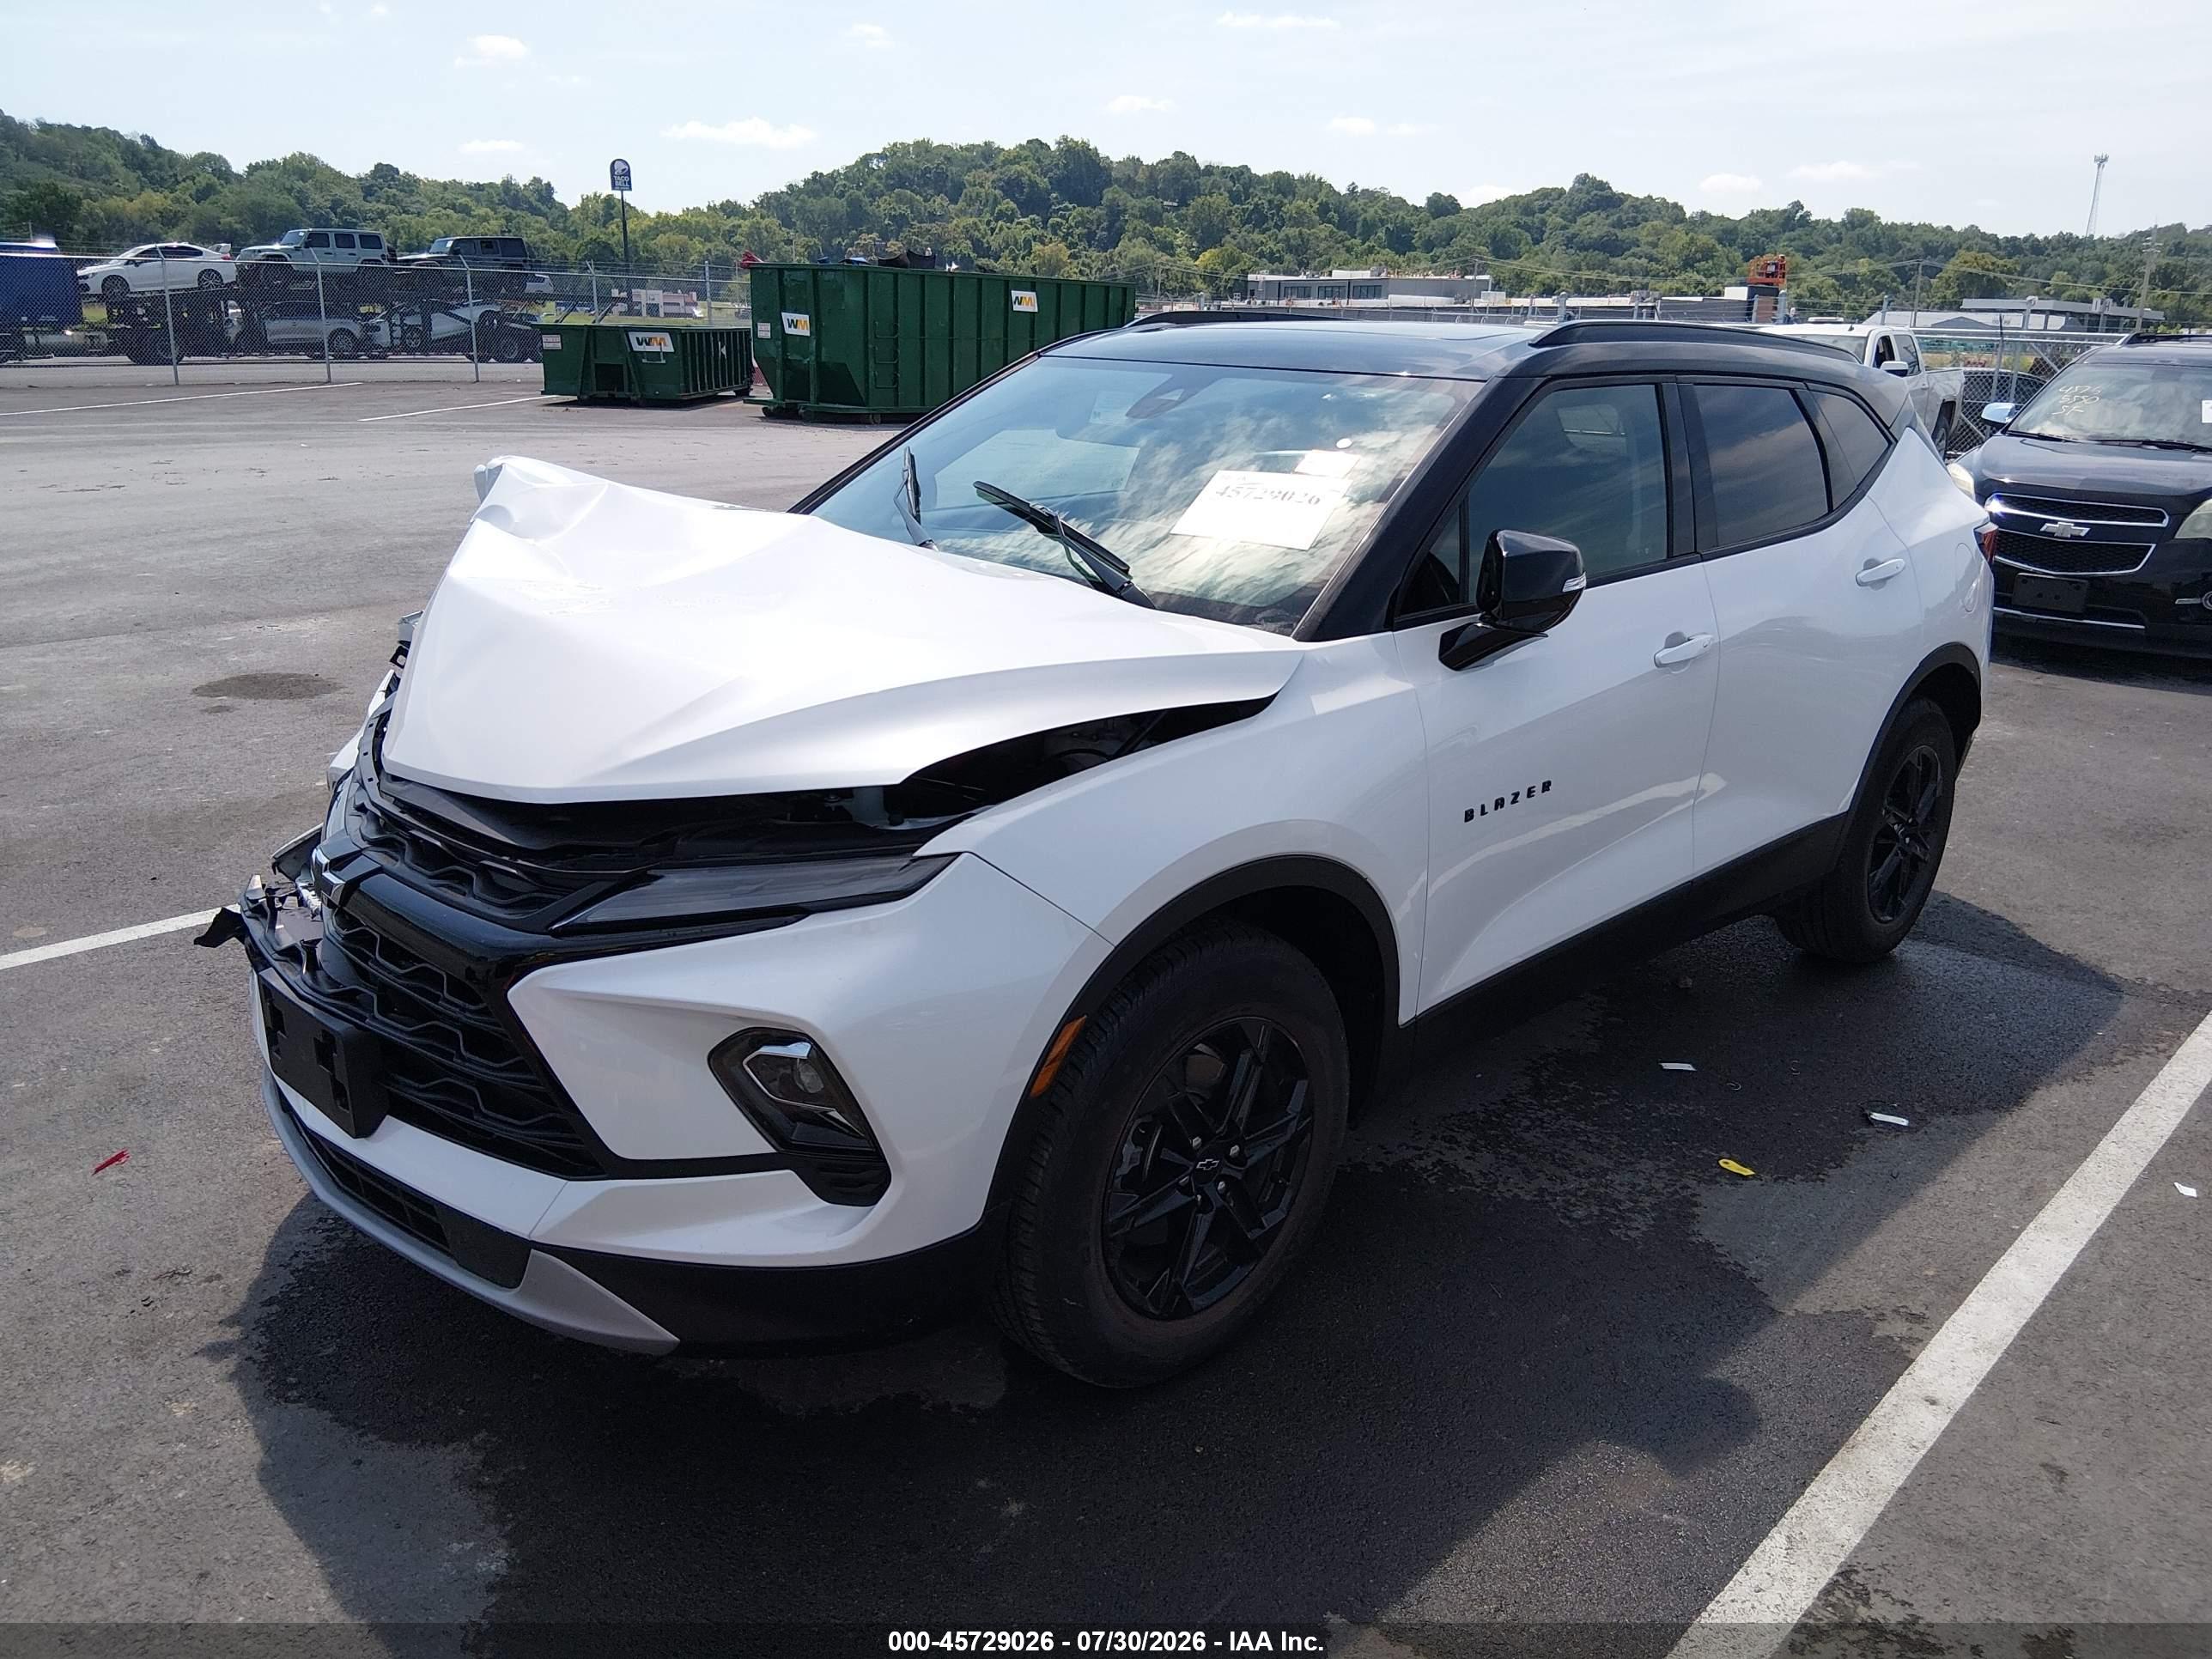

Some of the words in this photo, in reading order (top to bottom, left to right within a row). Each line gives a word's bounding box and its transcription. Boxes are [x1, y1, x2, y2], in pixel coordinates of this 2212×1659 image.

[1014, 295, 1035, 307] WM
[787, 318, 809, 331] WM
[635, 336, 667, 347] WM
[1464, 780, 1552, 823] BLAZER
